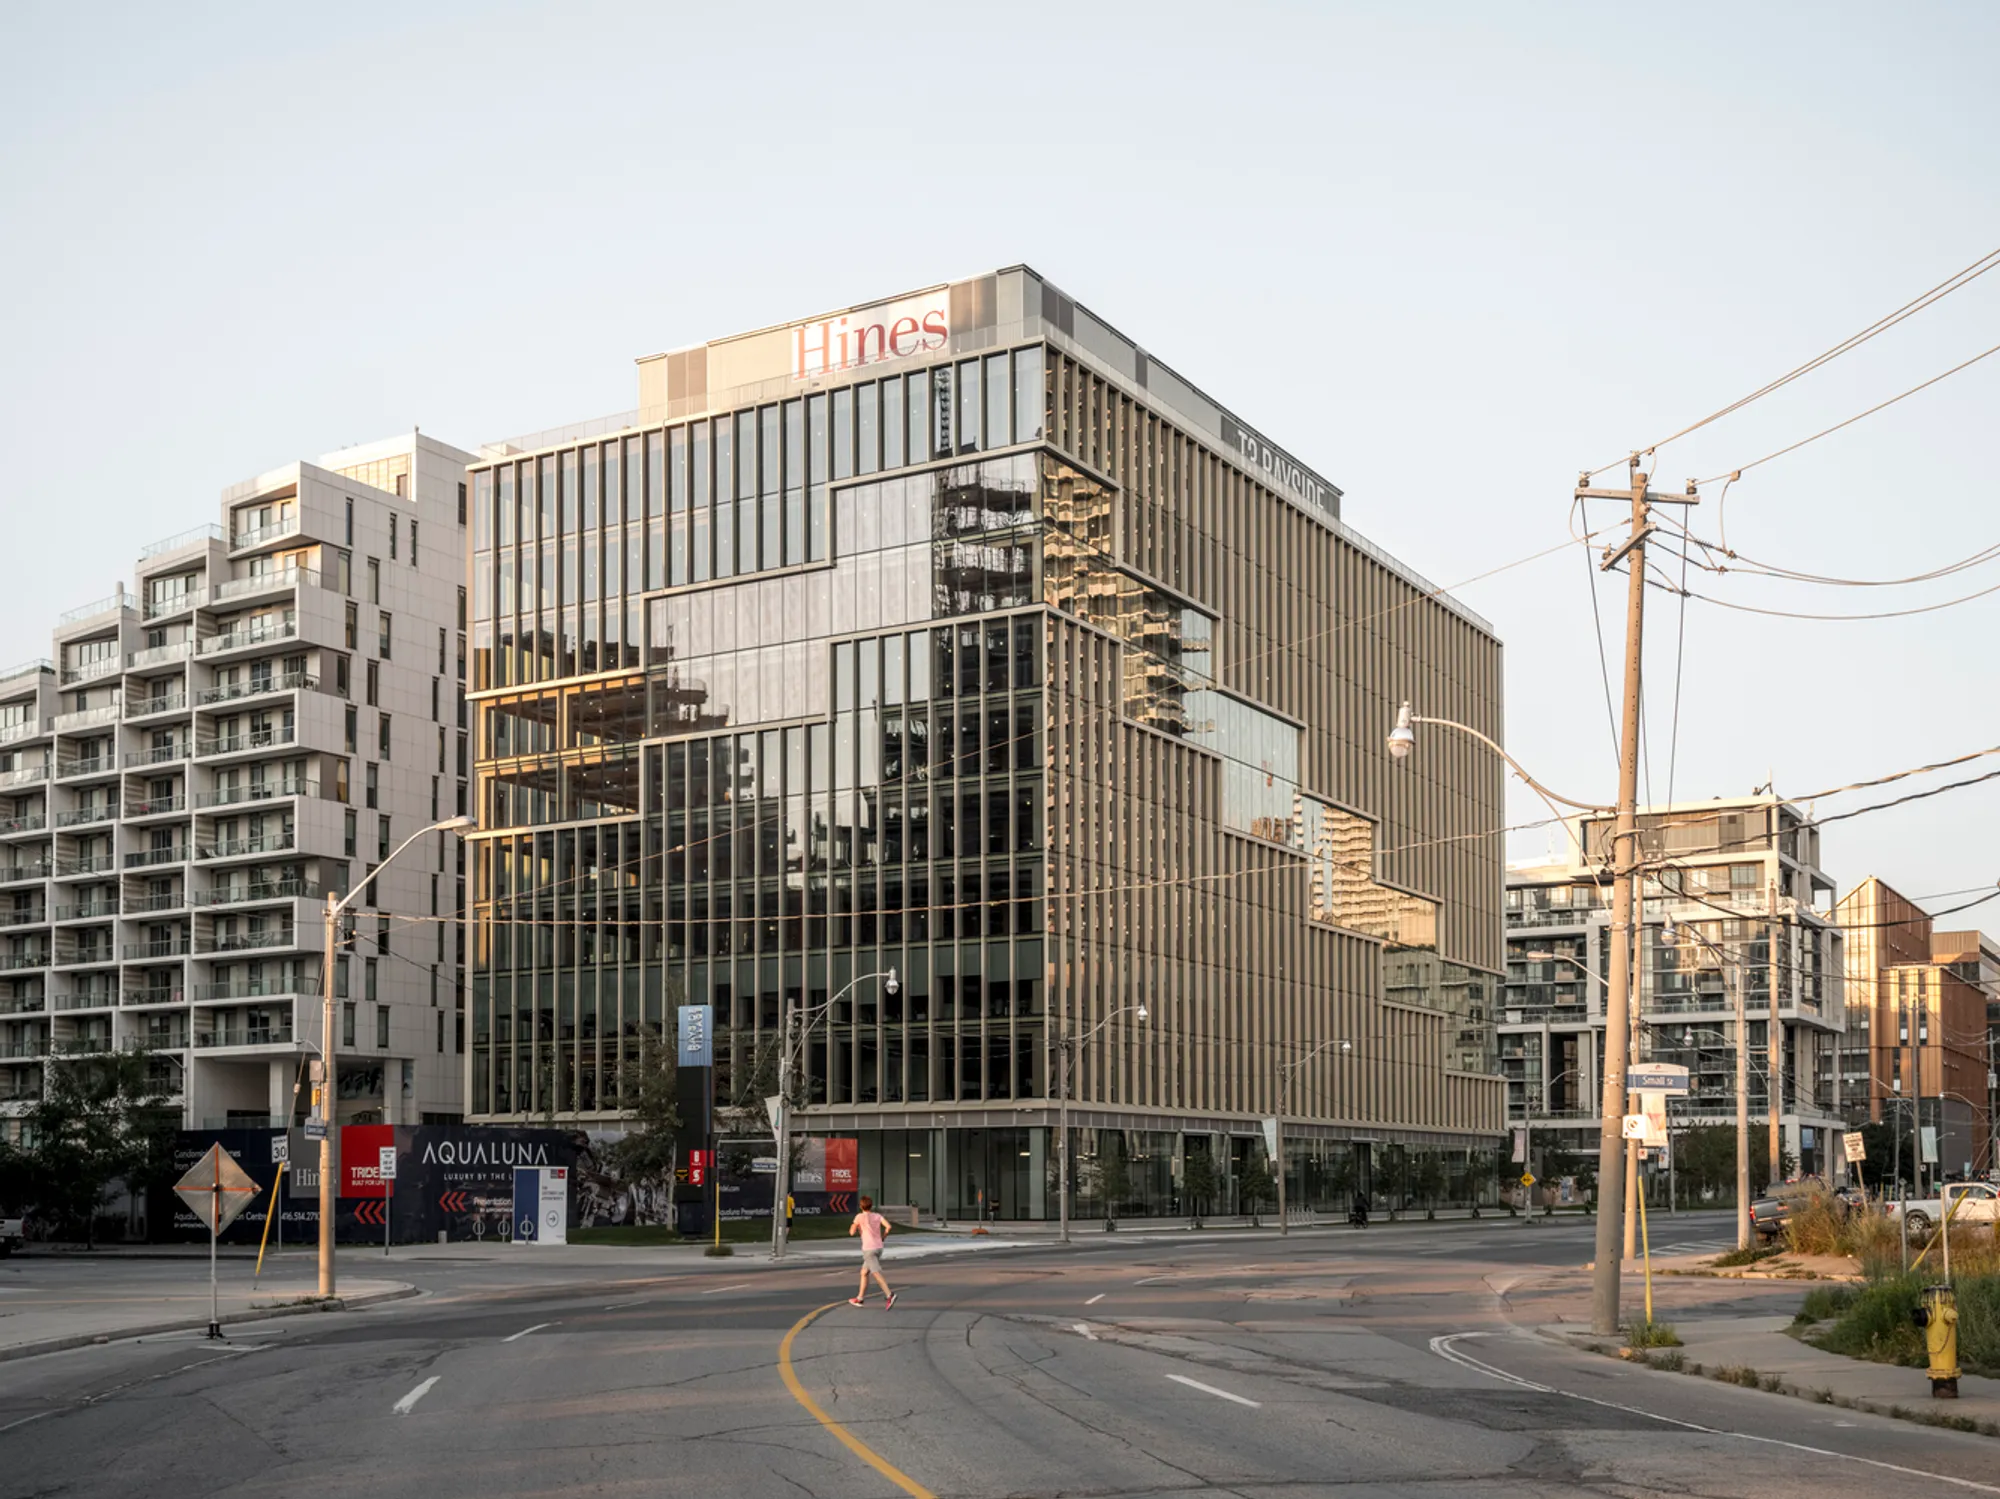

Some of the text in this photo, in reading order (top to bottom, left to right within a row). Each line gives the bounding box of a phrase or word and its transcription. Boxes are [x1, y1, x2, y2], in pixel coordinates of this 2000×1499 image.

[793, 309, 948, 381] Hines
[1642, 1075, 1665, 1086] Small
[273, 1147, 286, 1158] 30
[422, 1141, 548, 1165] AQUALUNA
[351, 1166, 380, 1178] TRIDE
